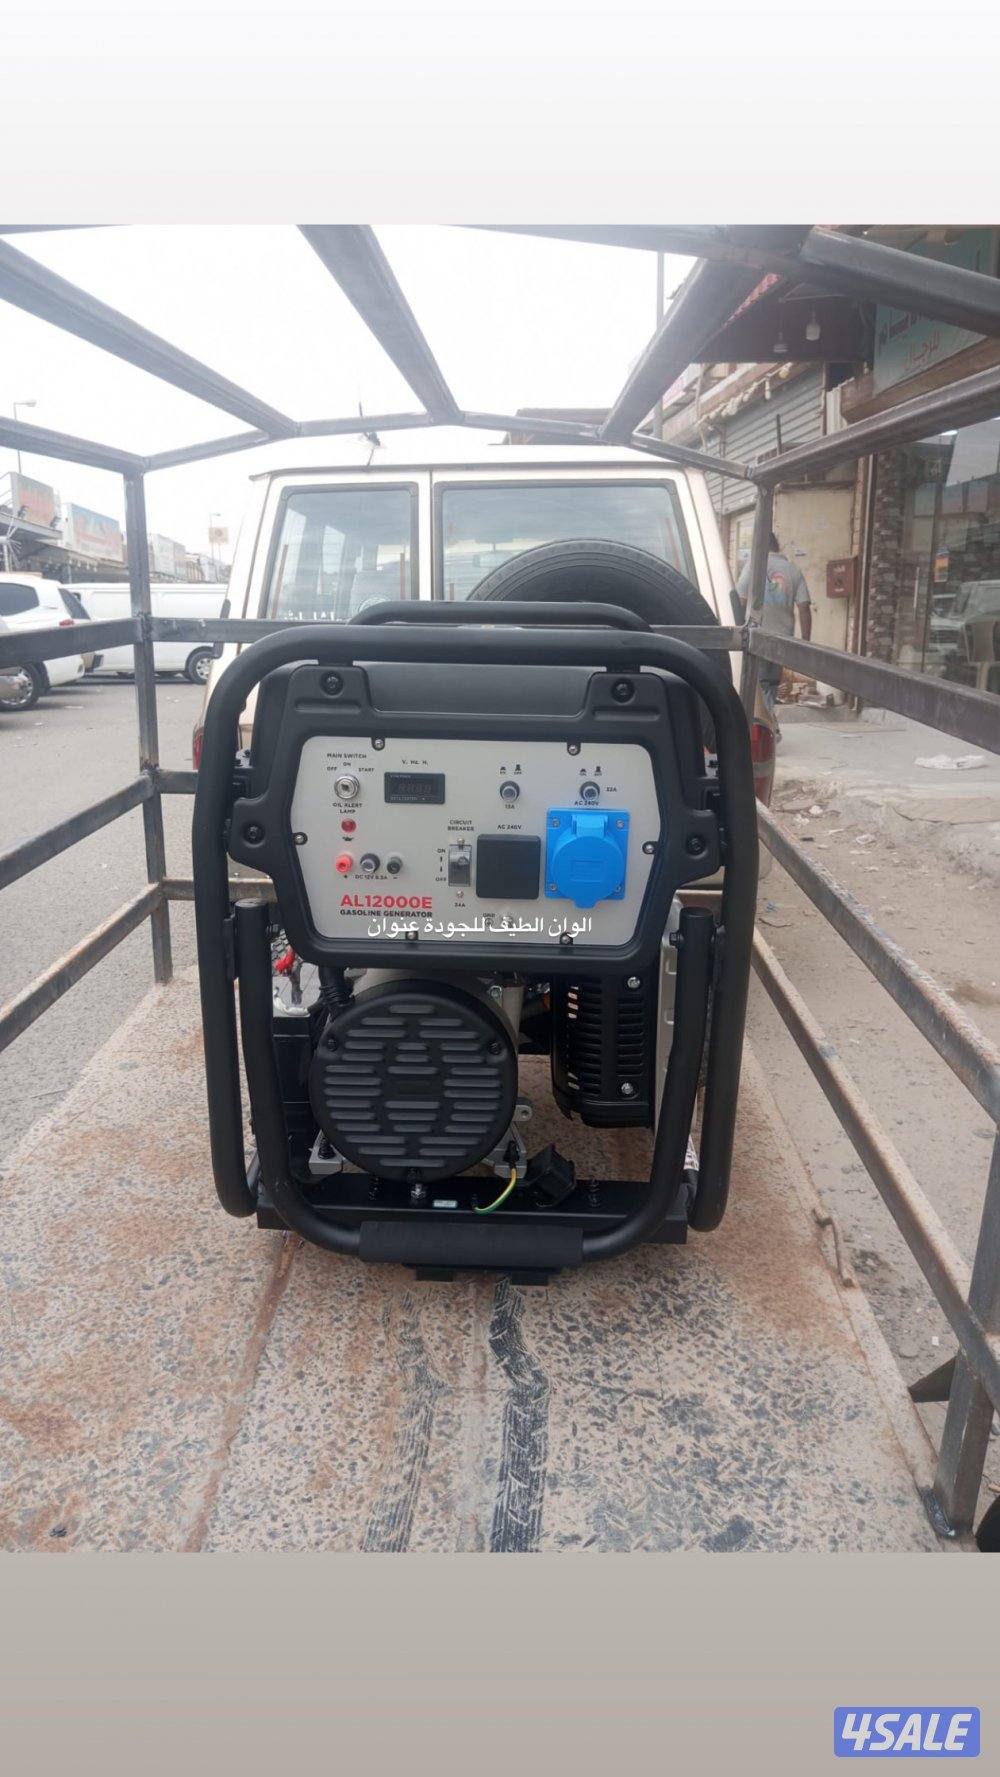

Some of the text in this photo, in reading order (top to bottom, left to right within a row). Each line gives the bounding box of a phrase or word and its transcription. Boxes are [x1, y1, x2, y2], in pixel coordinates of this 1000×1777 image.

[340, 894, 433, 909] AL12000E
[340, 909, 433, 918] GASOLINE GENERATOR
